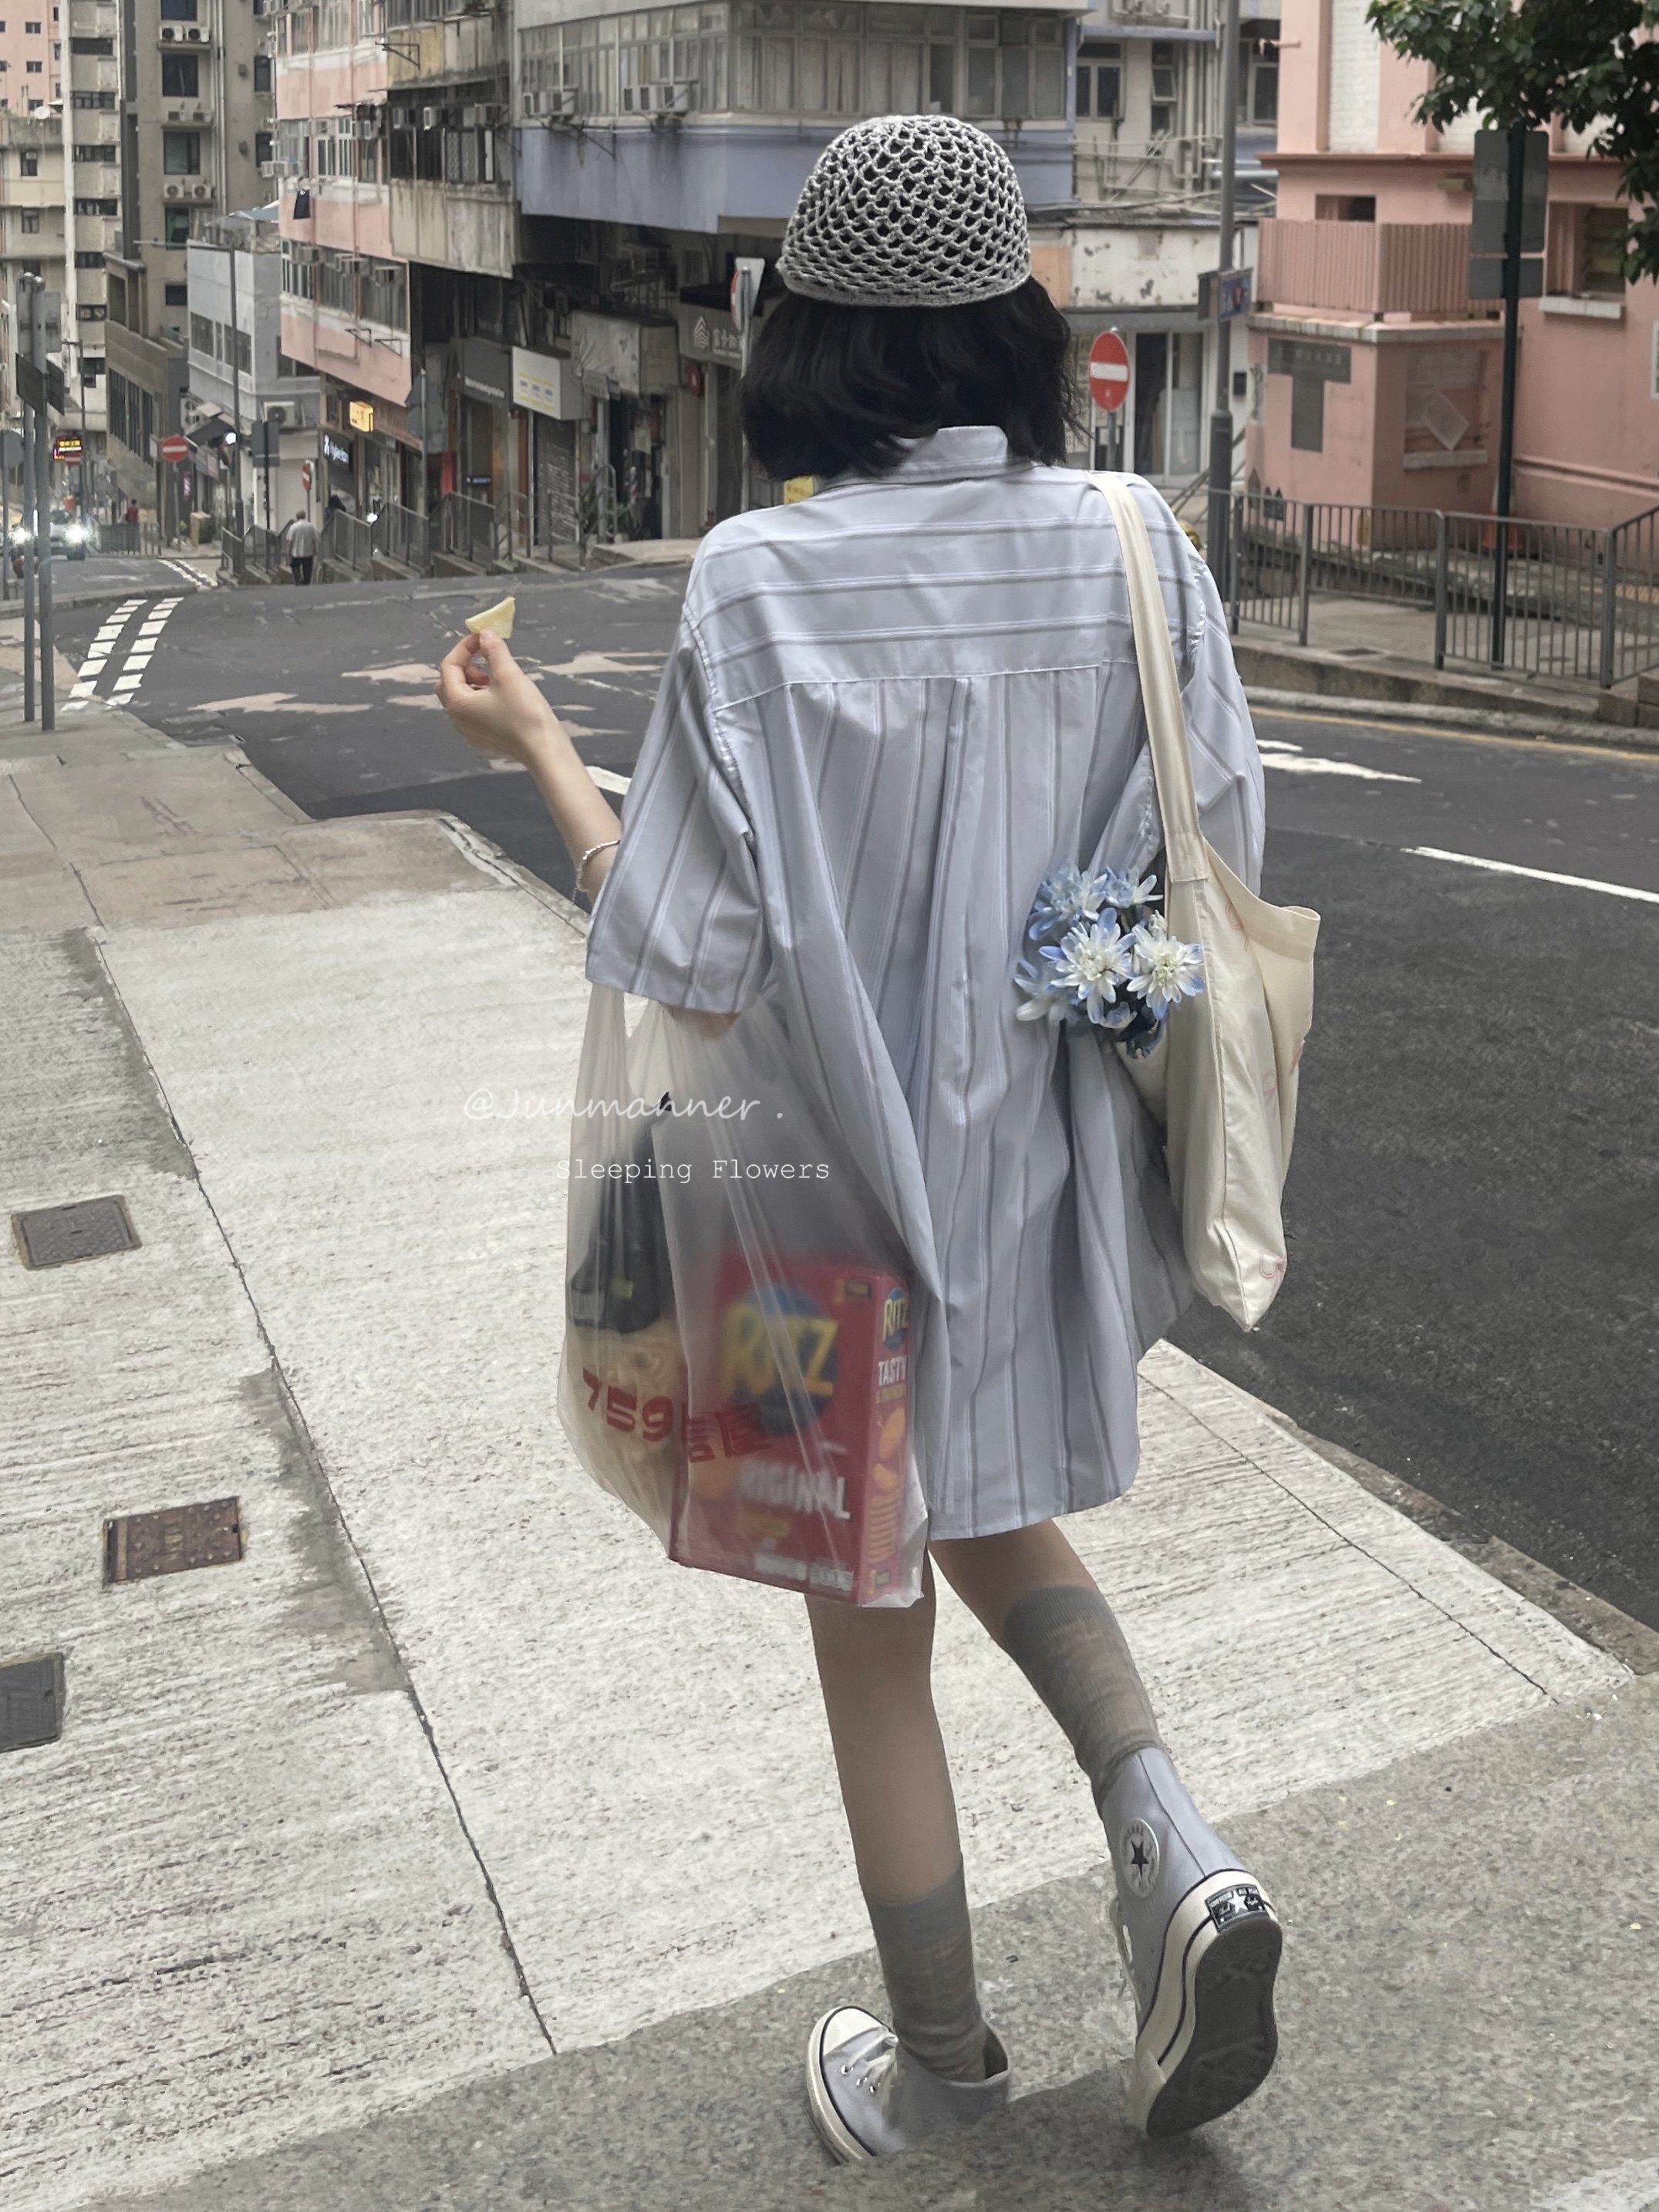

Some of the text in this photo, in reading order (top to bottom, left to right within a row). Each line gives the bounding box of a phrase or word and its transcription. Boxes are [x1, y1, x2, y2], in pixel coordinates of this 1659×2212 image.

[721, 1301, 838, 1398] RITZ
[882, 1297, 909, 1344] RITZ
[878, 1355, 908, 1387] TASTY
[582, 1367, 674, 1443] 759
